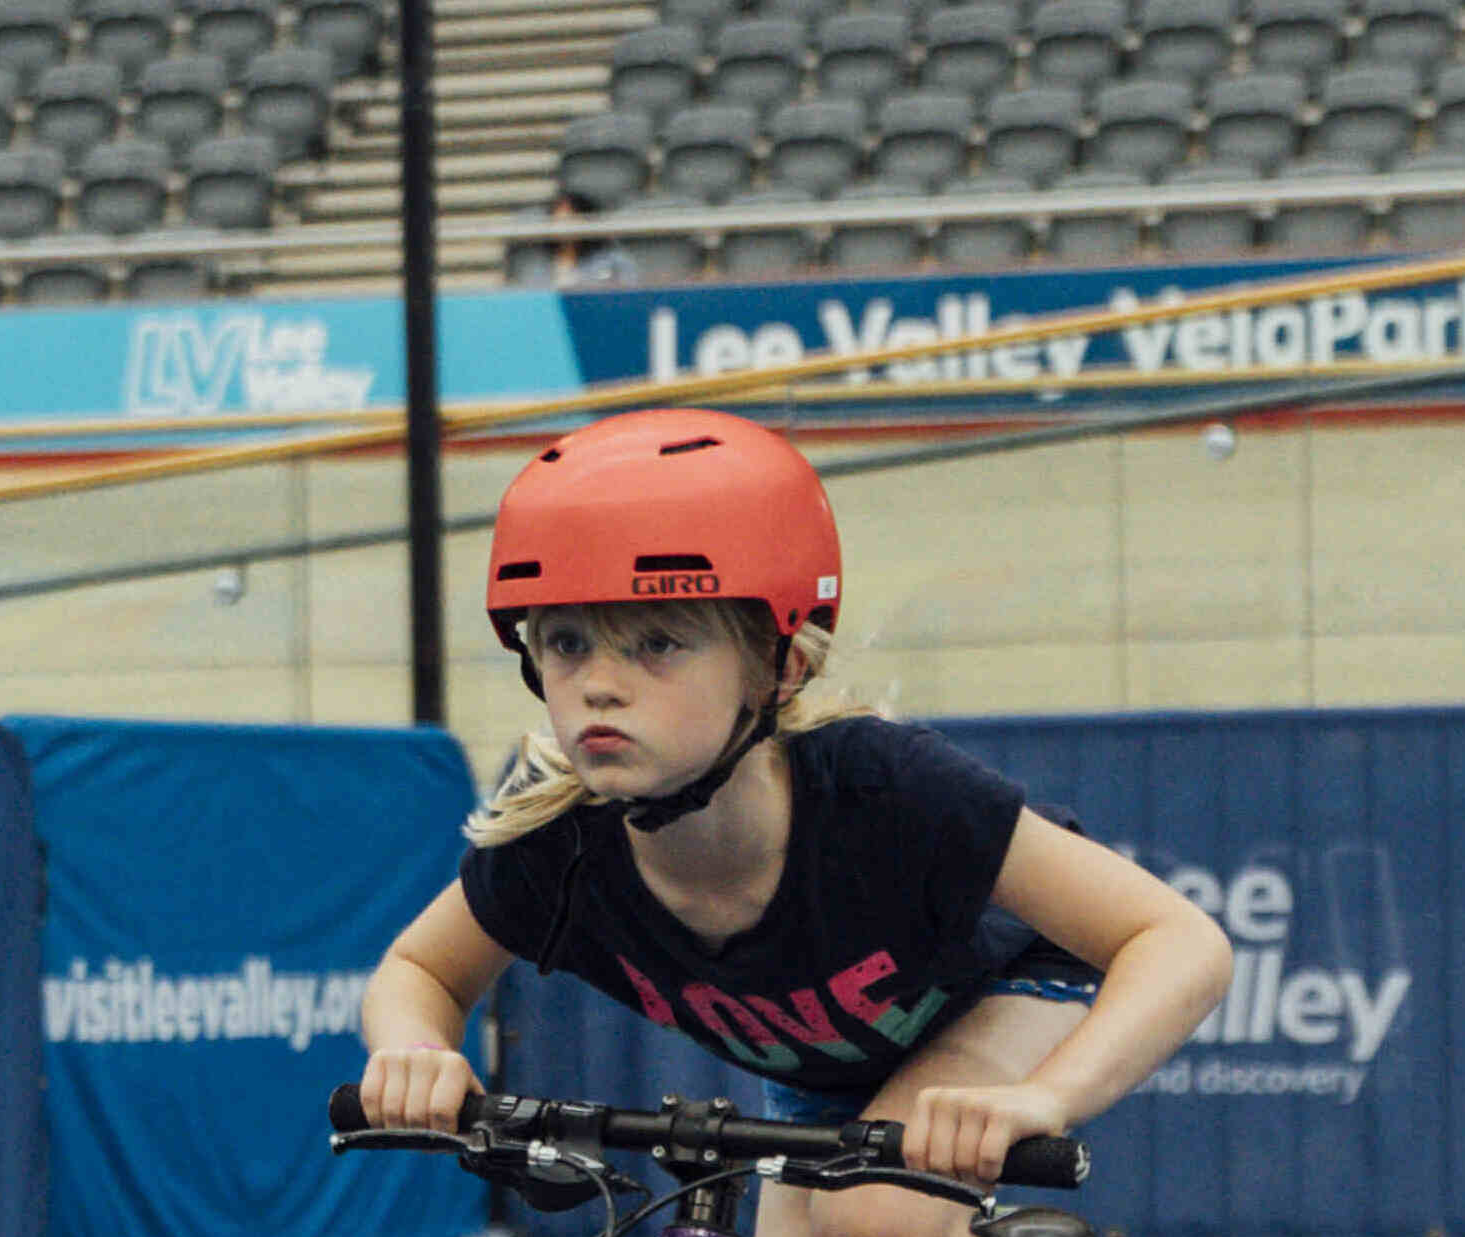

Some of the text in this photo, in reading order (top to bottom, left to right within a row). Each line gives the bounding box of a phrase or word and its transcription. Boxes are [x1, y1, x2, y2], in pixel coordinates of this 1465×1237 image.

[244, 313, 328, 361] Lee
[648, 307, 804, 383] Lee
[819, 293, 1088, 400] Valley
[632, 574, 720, 595] GIRO
[1120, 846, 1293, 942] ee
[1184, 947, 1412, 1062] lley
[1196, 1058, 1366, 1104] discovery
